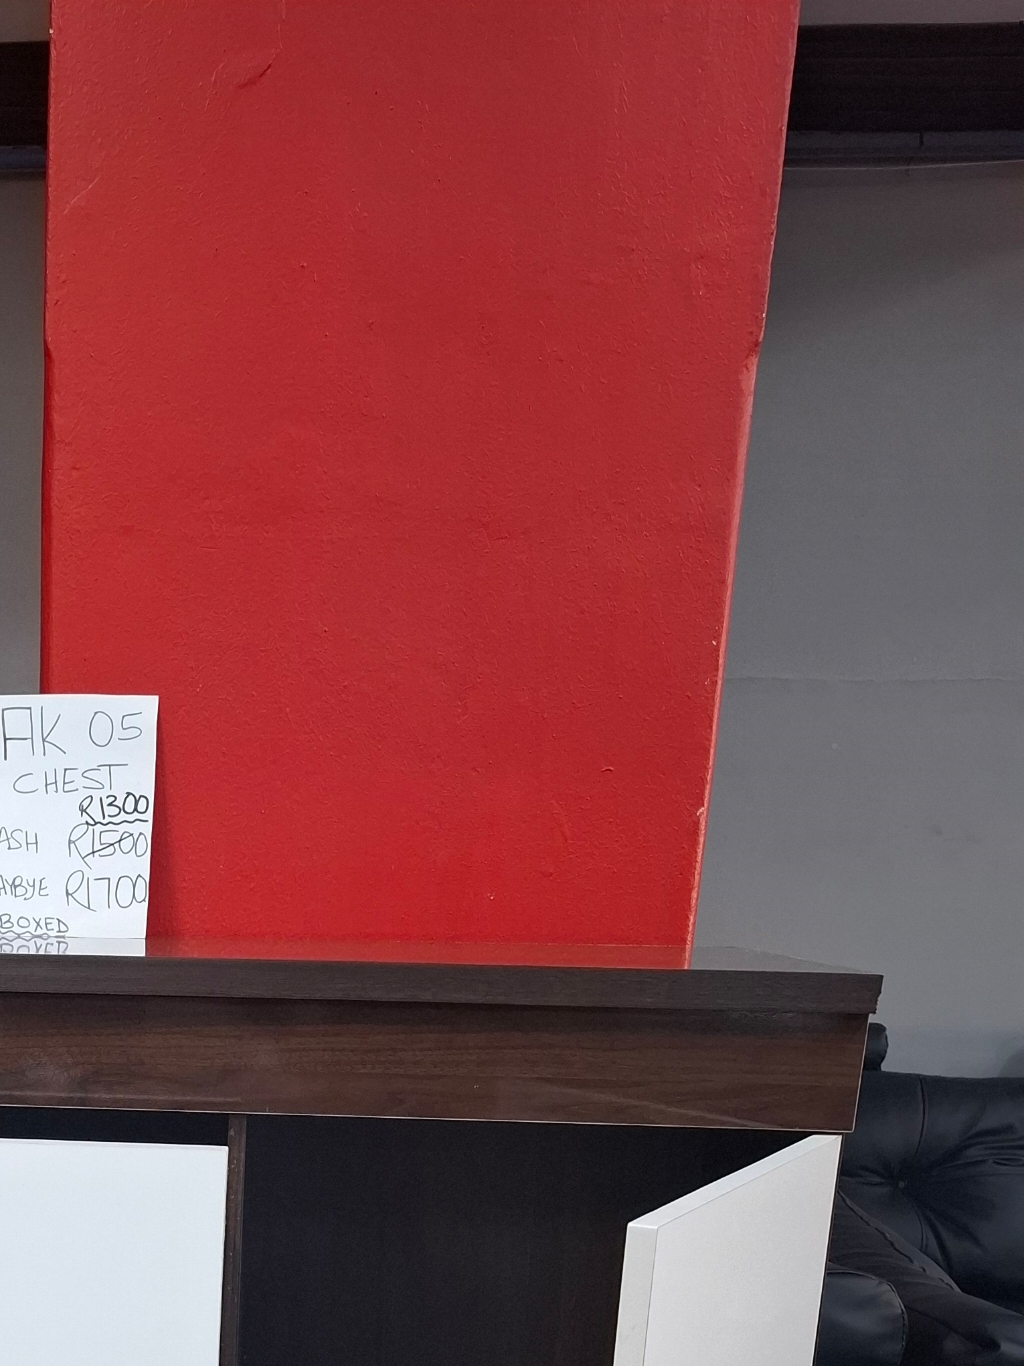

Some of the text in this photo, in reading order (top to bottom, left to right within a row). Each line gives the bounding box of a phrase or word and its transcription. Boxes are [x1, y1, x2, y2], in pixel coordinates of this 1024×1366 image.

[2, 705, 143, 761] AK 05
[13, 764, 129, 794] CHEST
[79, 792, 149, 825] R1300
[68, 823, 148, 870] R1500
[65, 870, 147, 912] R1700
